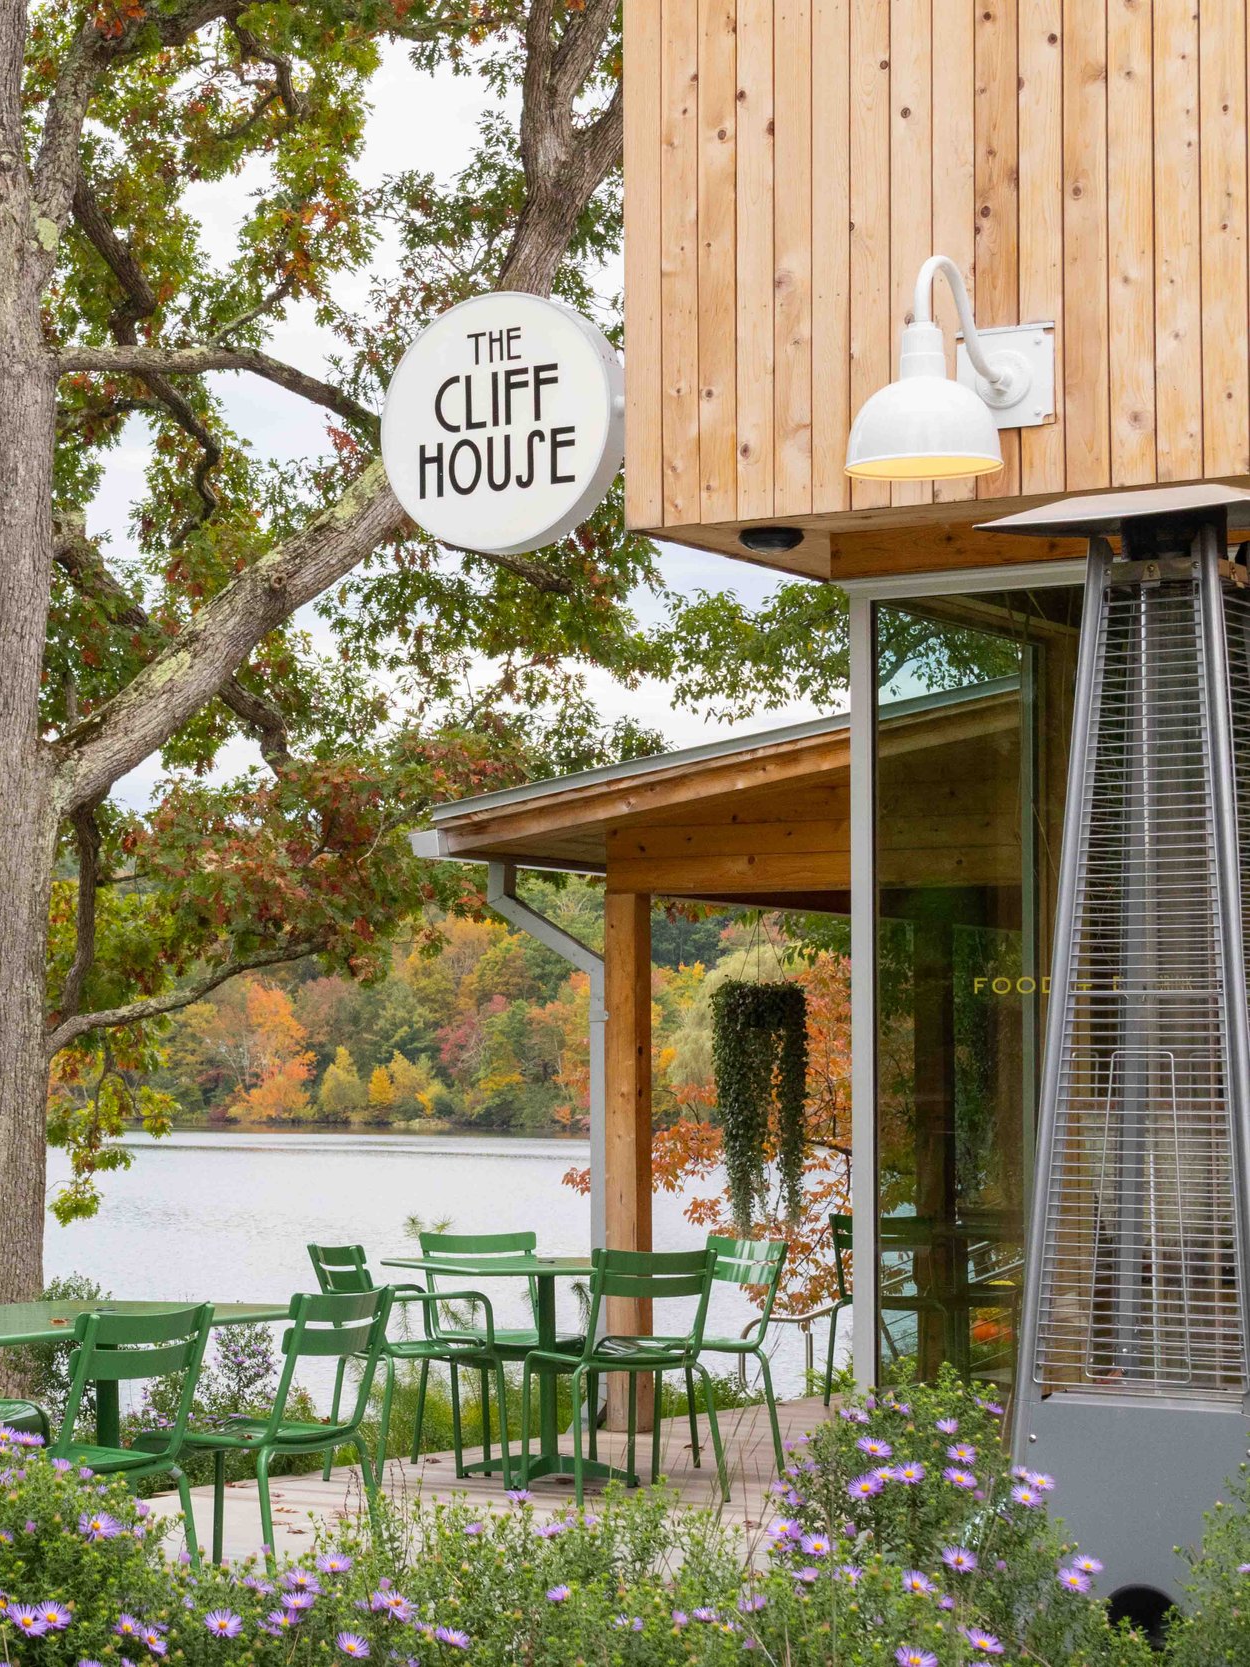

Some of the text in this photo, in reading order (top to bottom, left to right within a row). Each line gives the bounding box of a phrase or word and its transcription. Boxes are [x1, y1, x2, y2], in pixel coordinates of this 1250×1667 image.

[467, 327, 521, 365] THE
[434, 363, 558, 433] CLIFF
[419, 425, 575, 500] HOUSE
